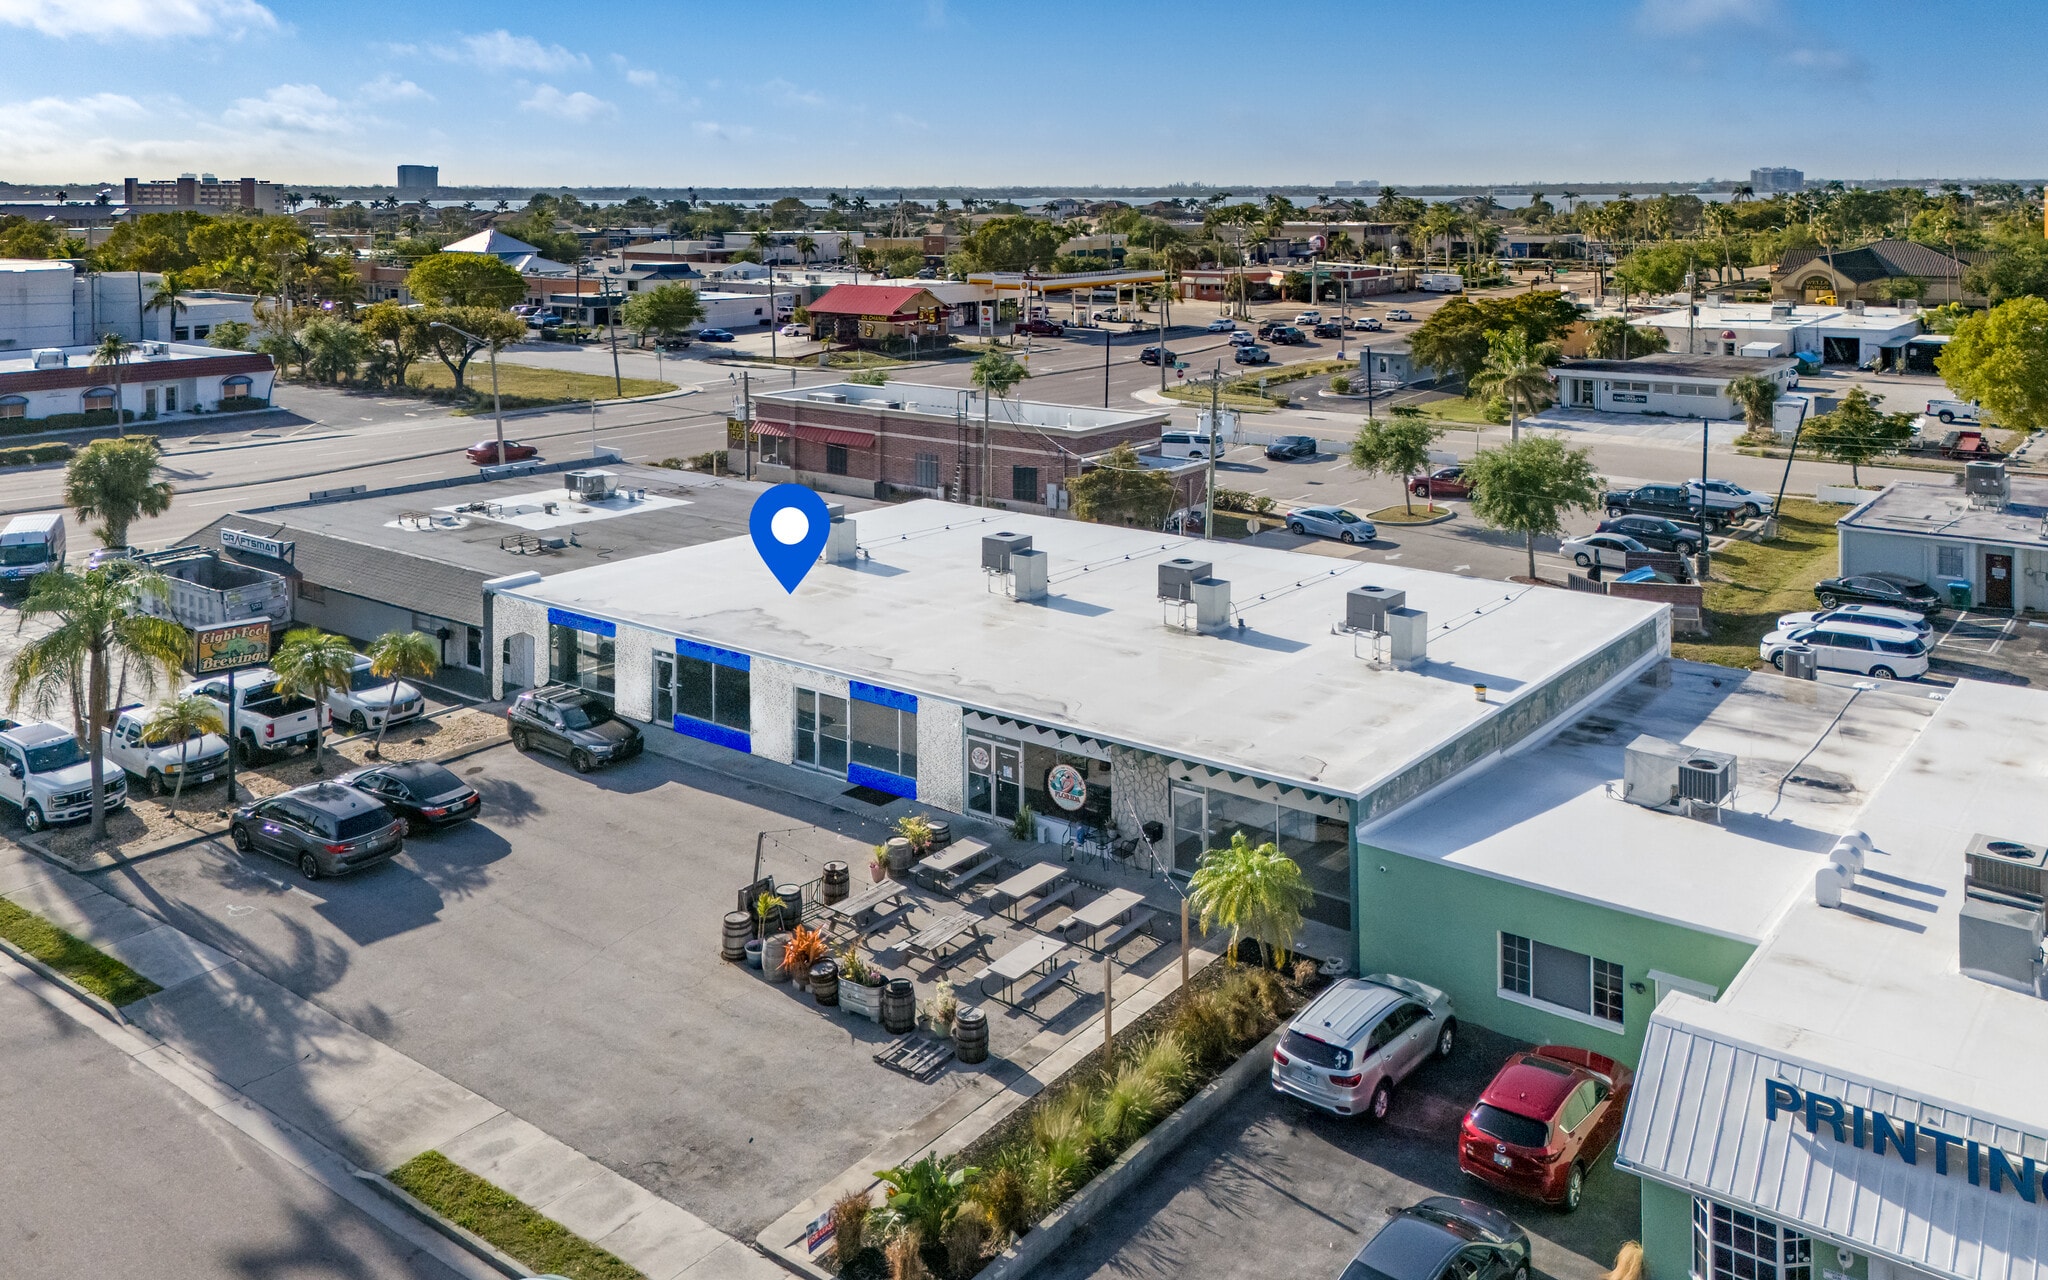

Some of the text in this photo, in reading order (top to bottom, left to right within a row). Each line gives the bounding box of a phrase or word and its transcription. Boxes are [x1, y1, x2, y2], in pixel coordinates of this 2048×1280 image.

[929, 313, 935, 323] 5
[222, 533, 277, 553] CRAFTSMAN
[201, 624, 268, 644] Eight Foot
[202, 652, 261, 670] Brewing
[1055, 791, 1081, 803] FLORIDA
[1765, 1076, 2048, 1204] PRINTIN
